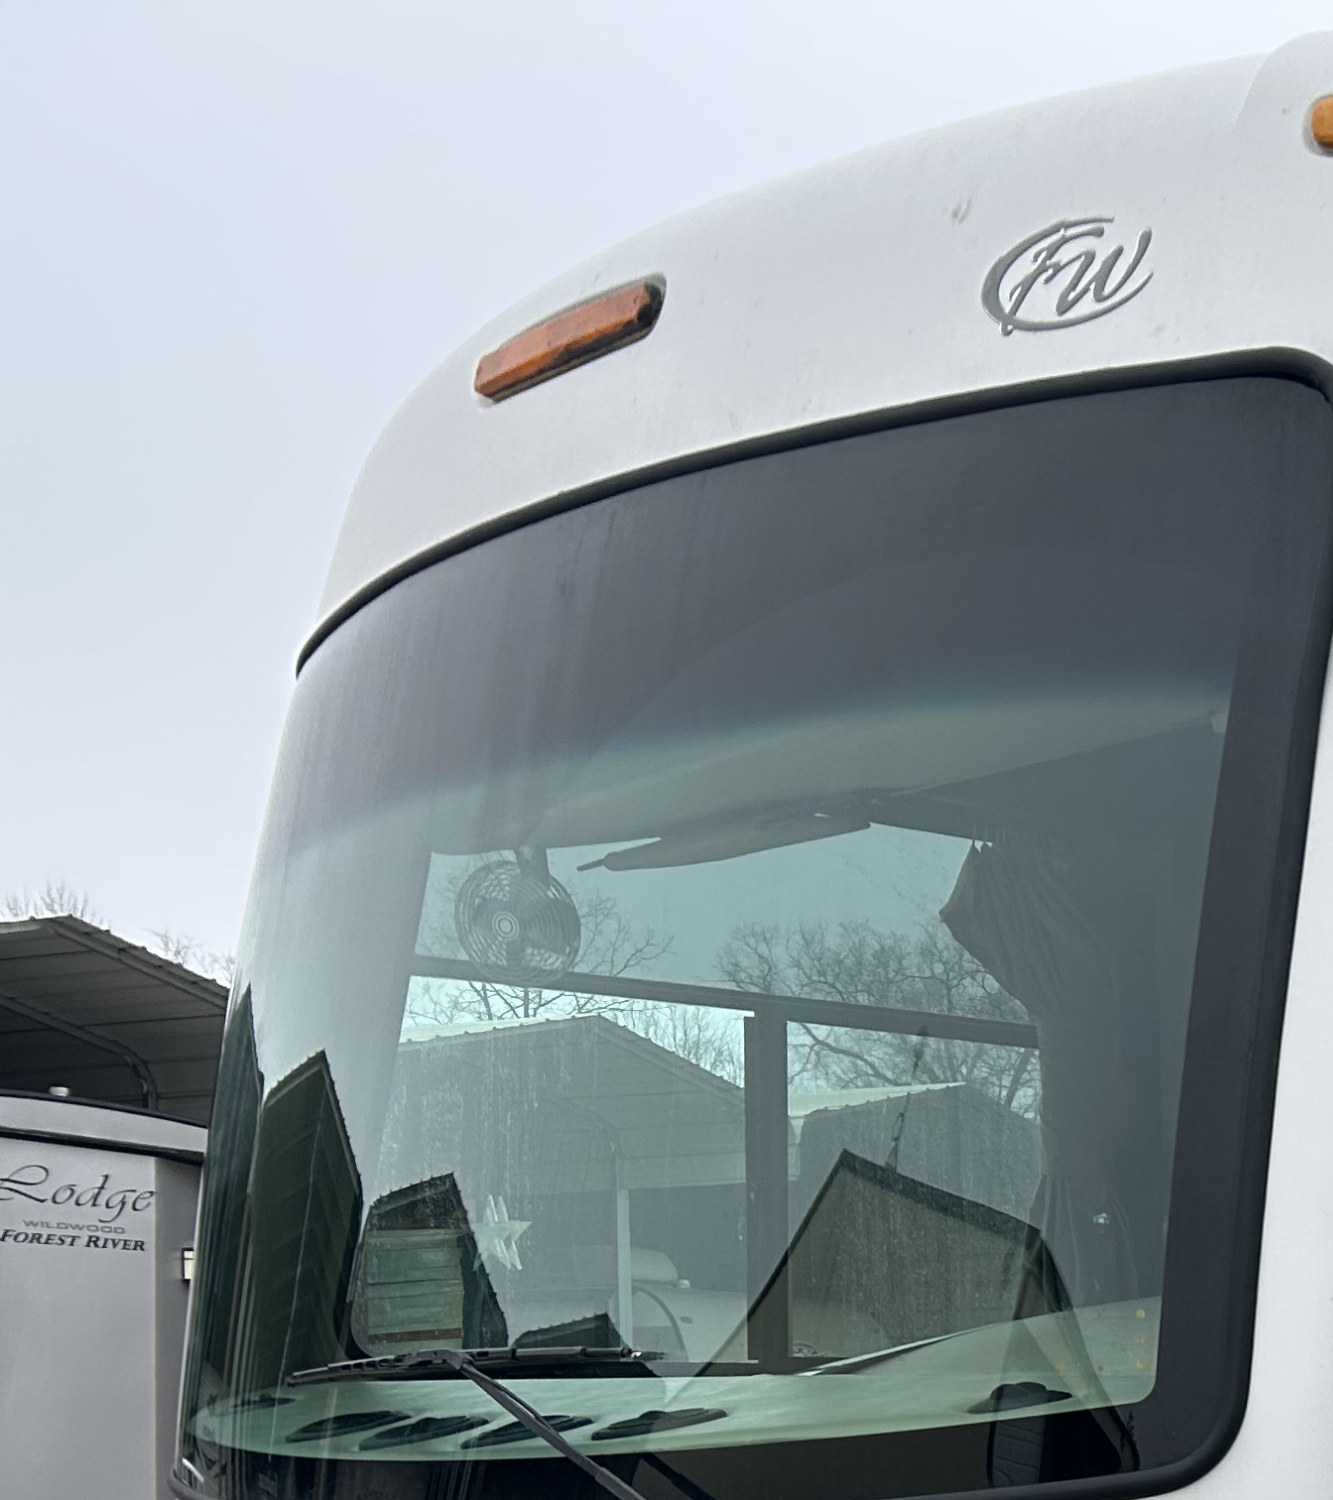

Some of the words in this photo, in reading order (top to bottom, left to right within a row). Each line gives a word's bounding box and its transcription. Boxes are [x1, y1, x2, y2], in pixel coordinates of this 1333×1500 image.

[0, 1165, 156, 1223] Lodge
[23, 1219, 126, 1234] WILDWOOD
[0, 1229, 81, 1247] FOREST
[85, 1235, 146, 1251] RIVER
